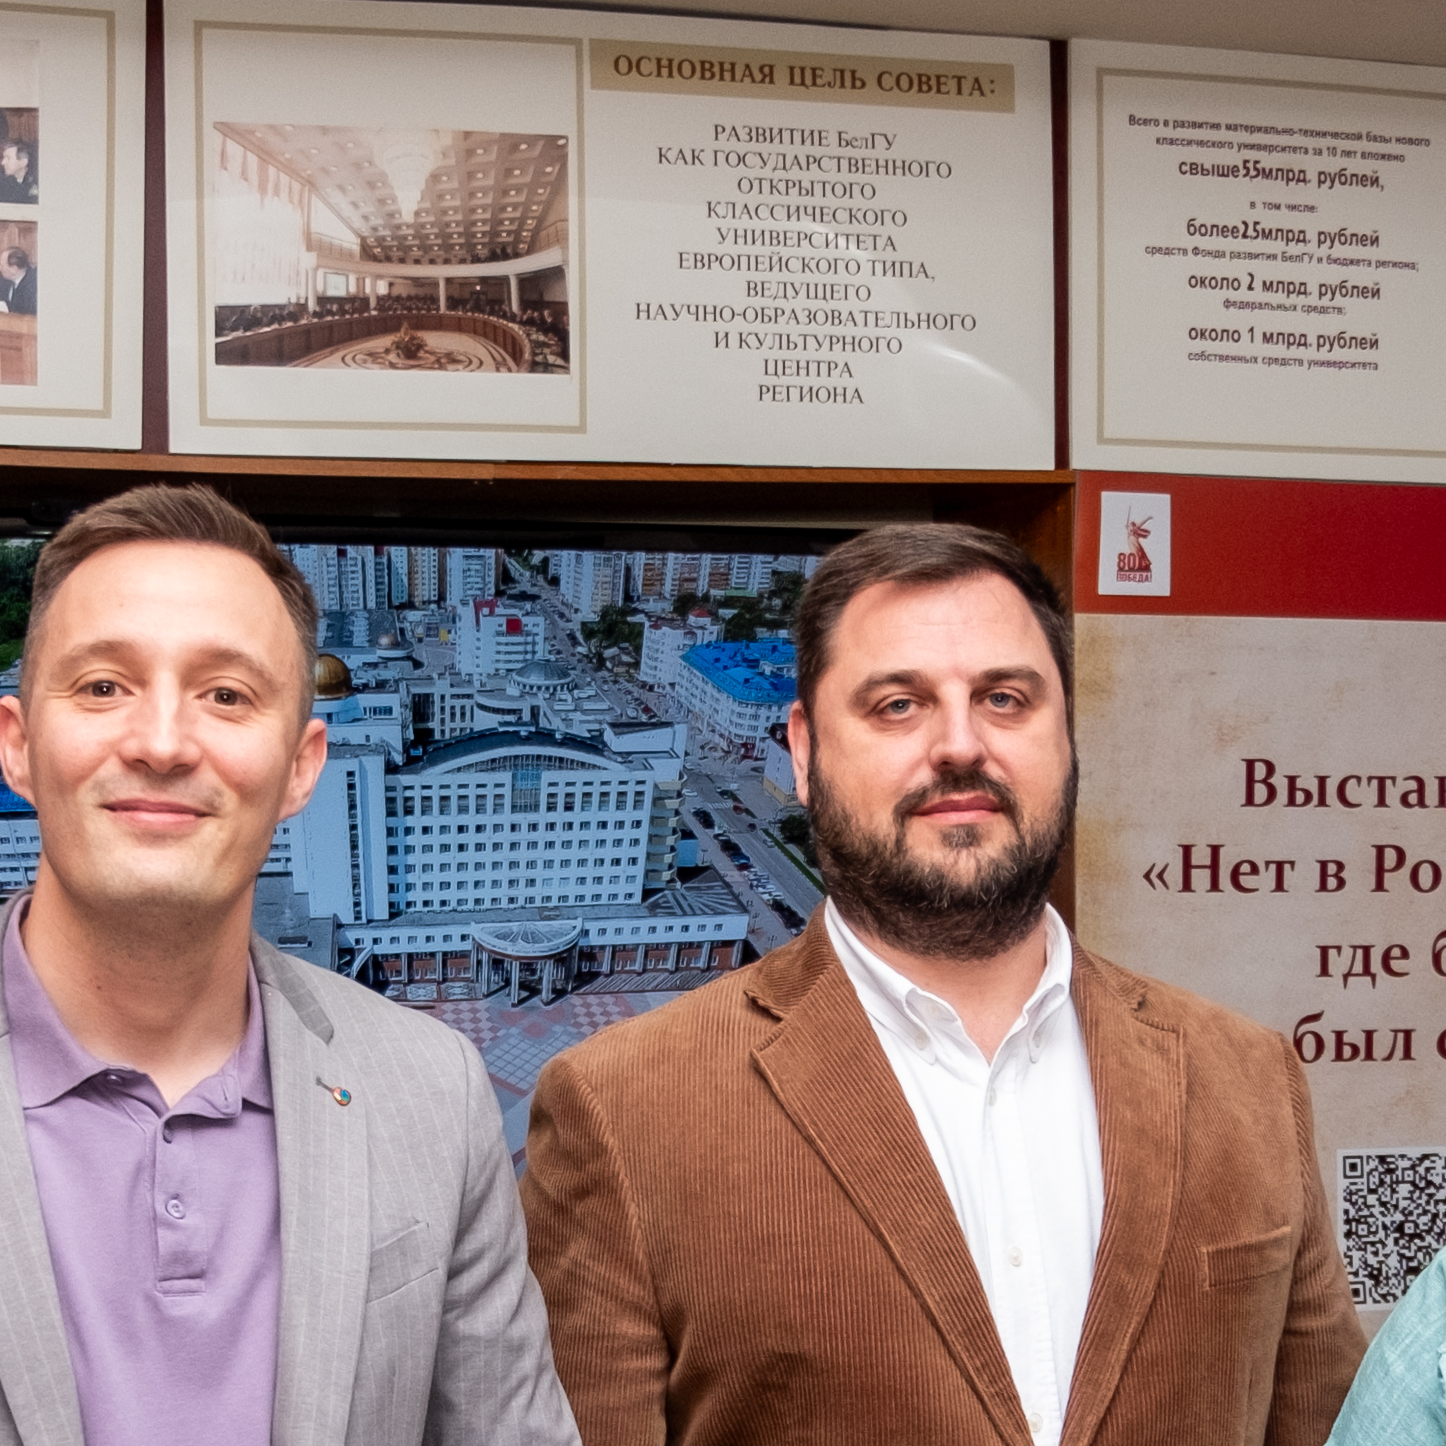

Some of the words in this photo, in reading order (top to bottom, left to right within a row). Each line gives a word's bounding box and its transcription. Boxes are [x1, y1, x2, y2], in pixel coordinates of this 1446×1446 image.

[612, 53, 777, 86] ОСНОВНАЯ
[786, 64, 868, 93] ЦЕЛЬ
[876, 69, 997, 99] СОВЕТА:
[1127, 113, 1160, 129] Всего
[712, 123, 831, 149] РАЗВИТИЕ
[836, 129, 898, 152] БелГУ
[656, 146, 706, 169] КАК
[711, 148, 953, 180] ГОСУДАРСТВЕННОГО
[736, 175, 877, 201] ОТКРЫТОГО
[1316, 168, 1385, 192] рублей,
[704, 200, 909, 229] КЛАССИЧЕСКОГО
[1262, 201, 1282, 211] том
[715, 227, 899, 254] УНИВЕРСИТЕТА
[1316, 228, 1381, 250] рублей
[676, 251, 861, 278] ЕВРОПЕЙСКОГО
[866, 257, 937, 283] ТИПА,
[745, 279, 872, 305] ВЕДУЩЕГО
[1187, 274, 1242, 293] около
[1246, 273, 1255, 292] 2
[1261, 279, 1313, 300] млрд.
[1318, 280, 1381, 302] рублей
[633, 302, 978, 333] НАУЧНО-ОБРАЗОВАТЕЛЬНОГО
[714, 331, 731, 351] И
[736, 331, 904, 356] КУЛЬТУРНОГО
[1187, 326, 1242, 345] около
[1247, 325, 1255, 344] 1
[1261, 330, 1313, 351] млрд.
[1316, 331, 1380, 354] рублей
[762, 358, 855, 382] ЦЕНТРА
[757, 384, 866, 406] РЕГИОНА
[1142, 843, 1296, 894] «Нет
[1315, 860, 1347, 894] в
[1315, 944, 1411, 990] где
[1293, 1011, 1417, 1066] был
